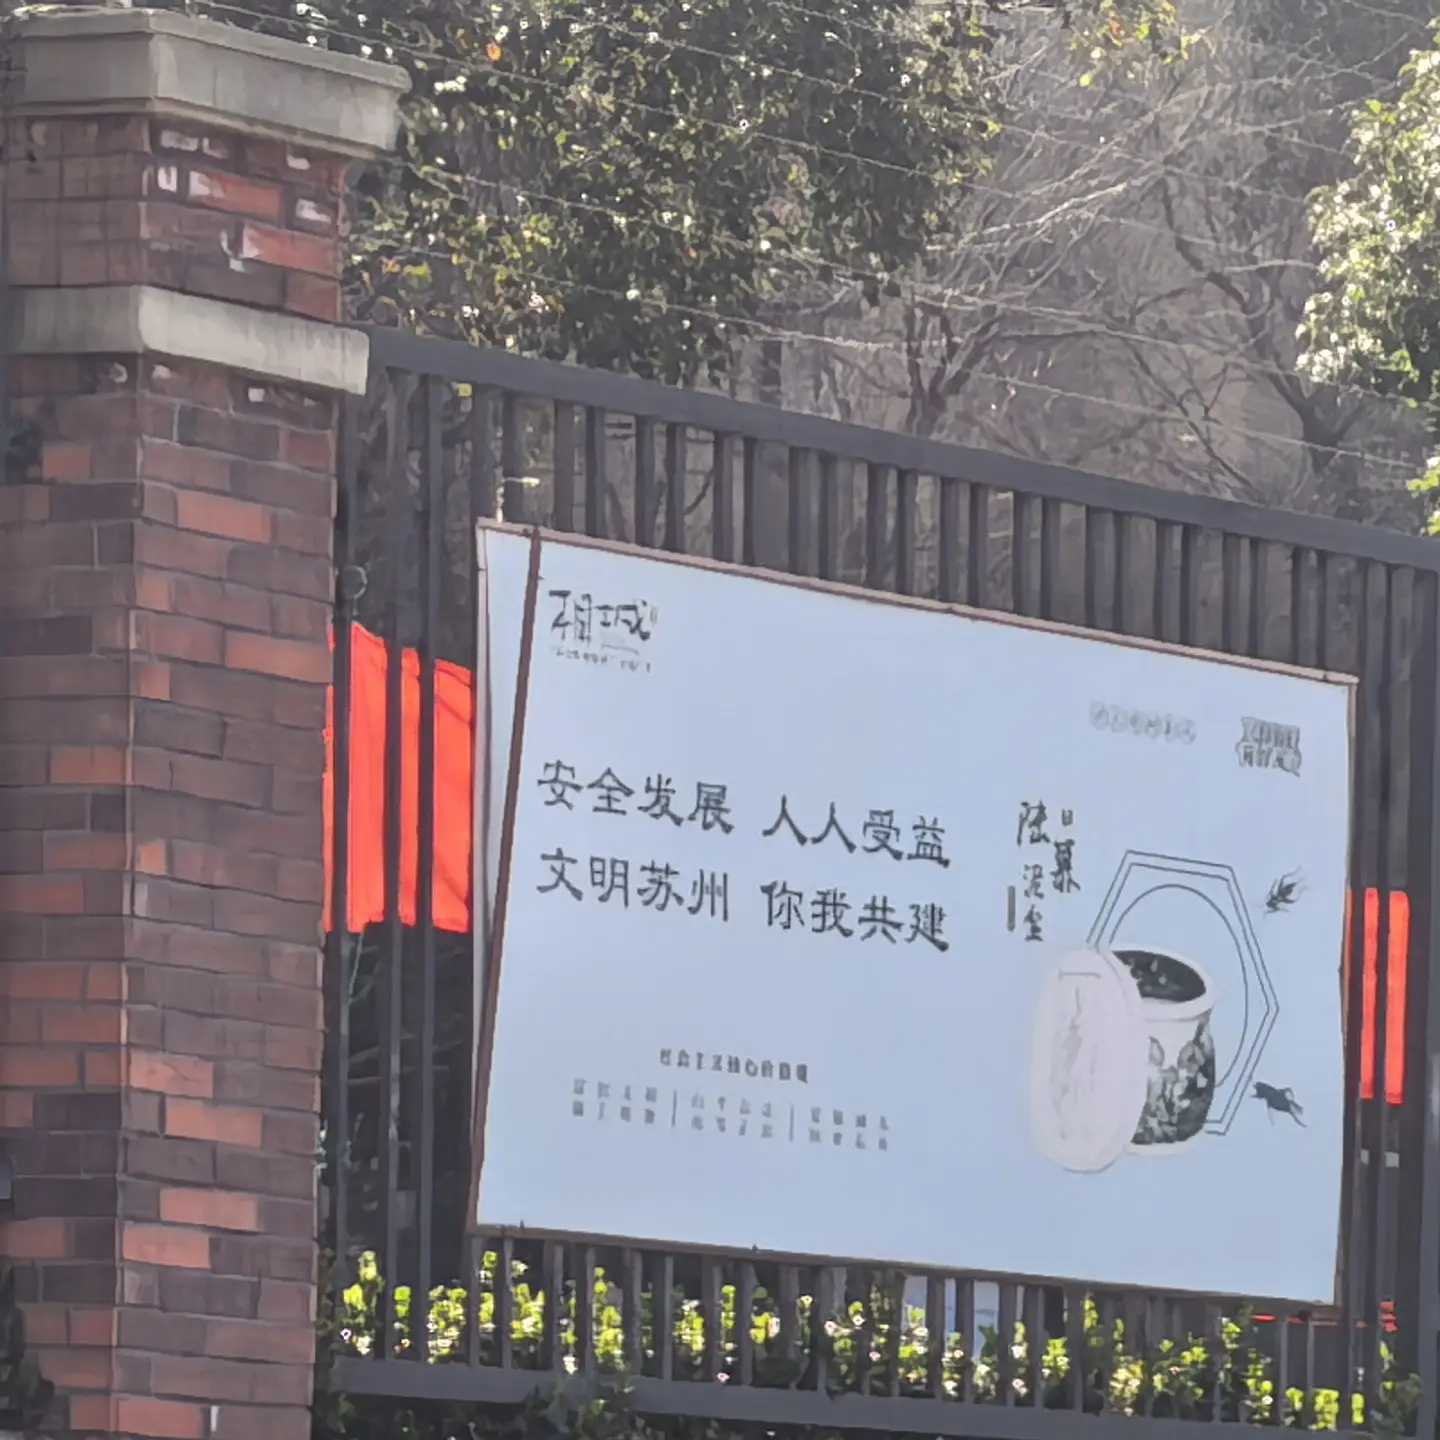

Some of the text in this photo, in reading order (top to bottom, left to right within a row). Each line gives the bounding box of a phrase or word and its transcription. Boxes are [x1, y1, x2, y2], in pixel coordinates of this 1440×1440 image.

[537, 759, 950, 868] 安全发展 人人受益
[537, 847, 729, 922] 文明苏州
[760, 880, 949, 952] 你我共建
